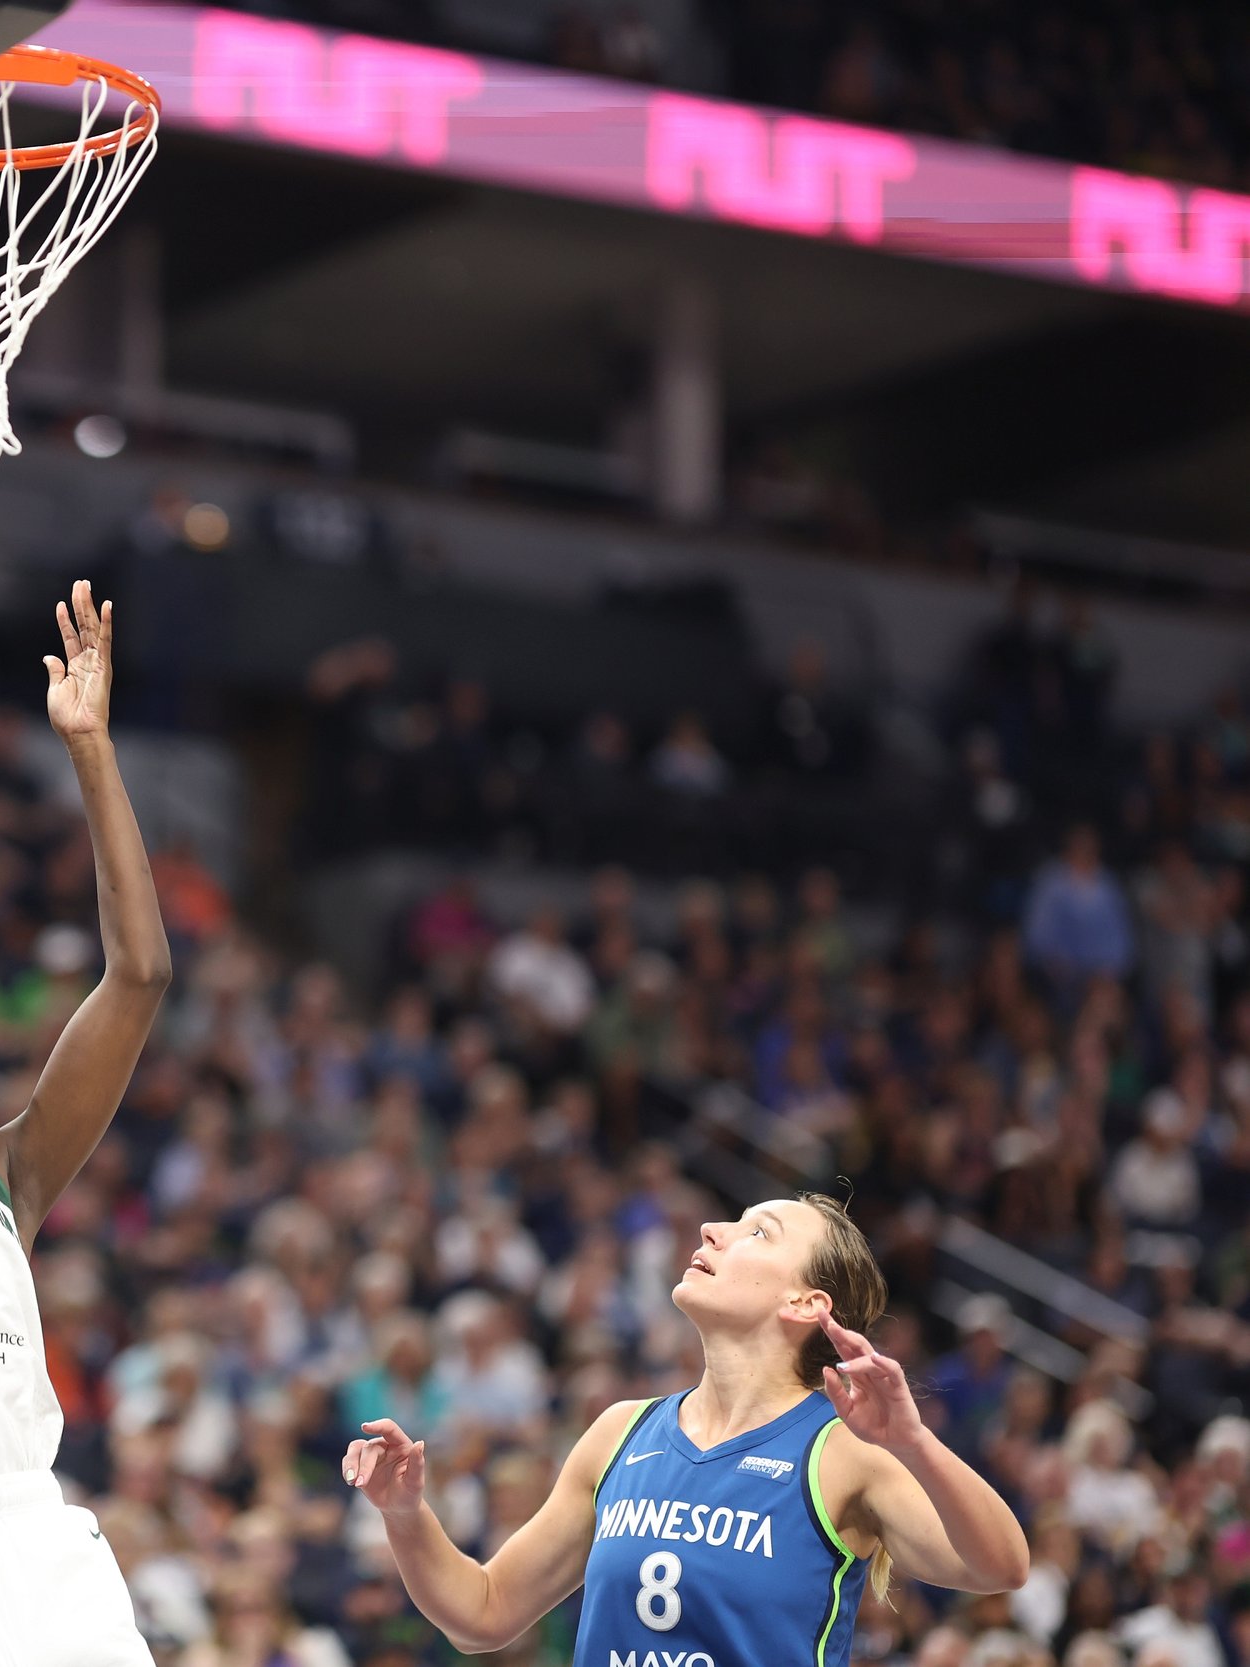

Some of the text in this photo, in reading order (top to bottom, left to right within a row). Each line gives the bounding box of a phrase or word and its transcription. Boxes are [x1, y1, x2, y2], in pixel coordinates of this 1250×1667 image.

[742, 1456, 794, 1472] FEDERATED
[596, 1499, 773, 1559] MINNESOTA
[636, 1551, 682, 1632] 8
